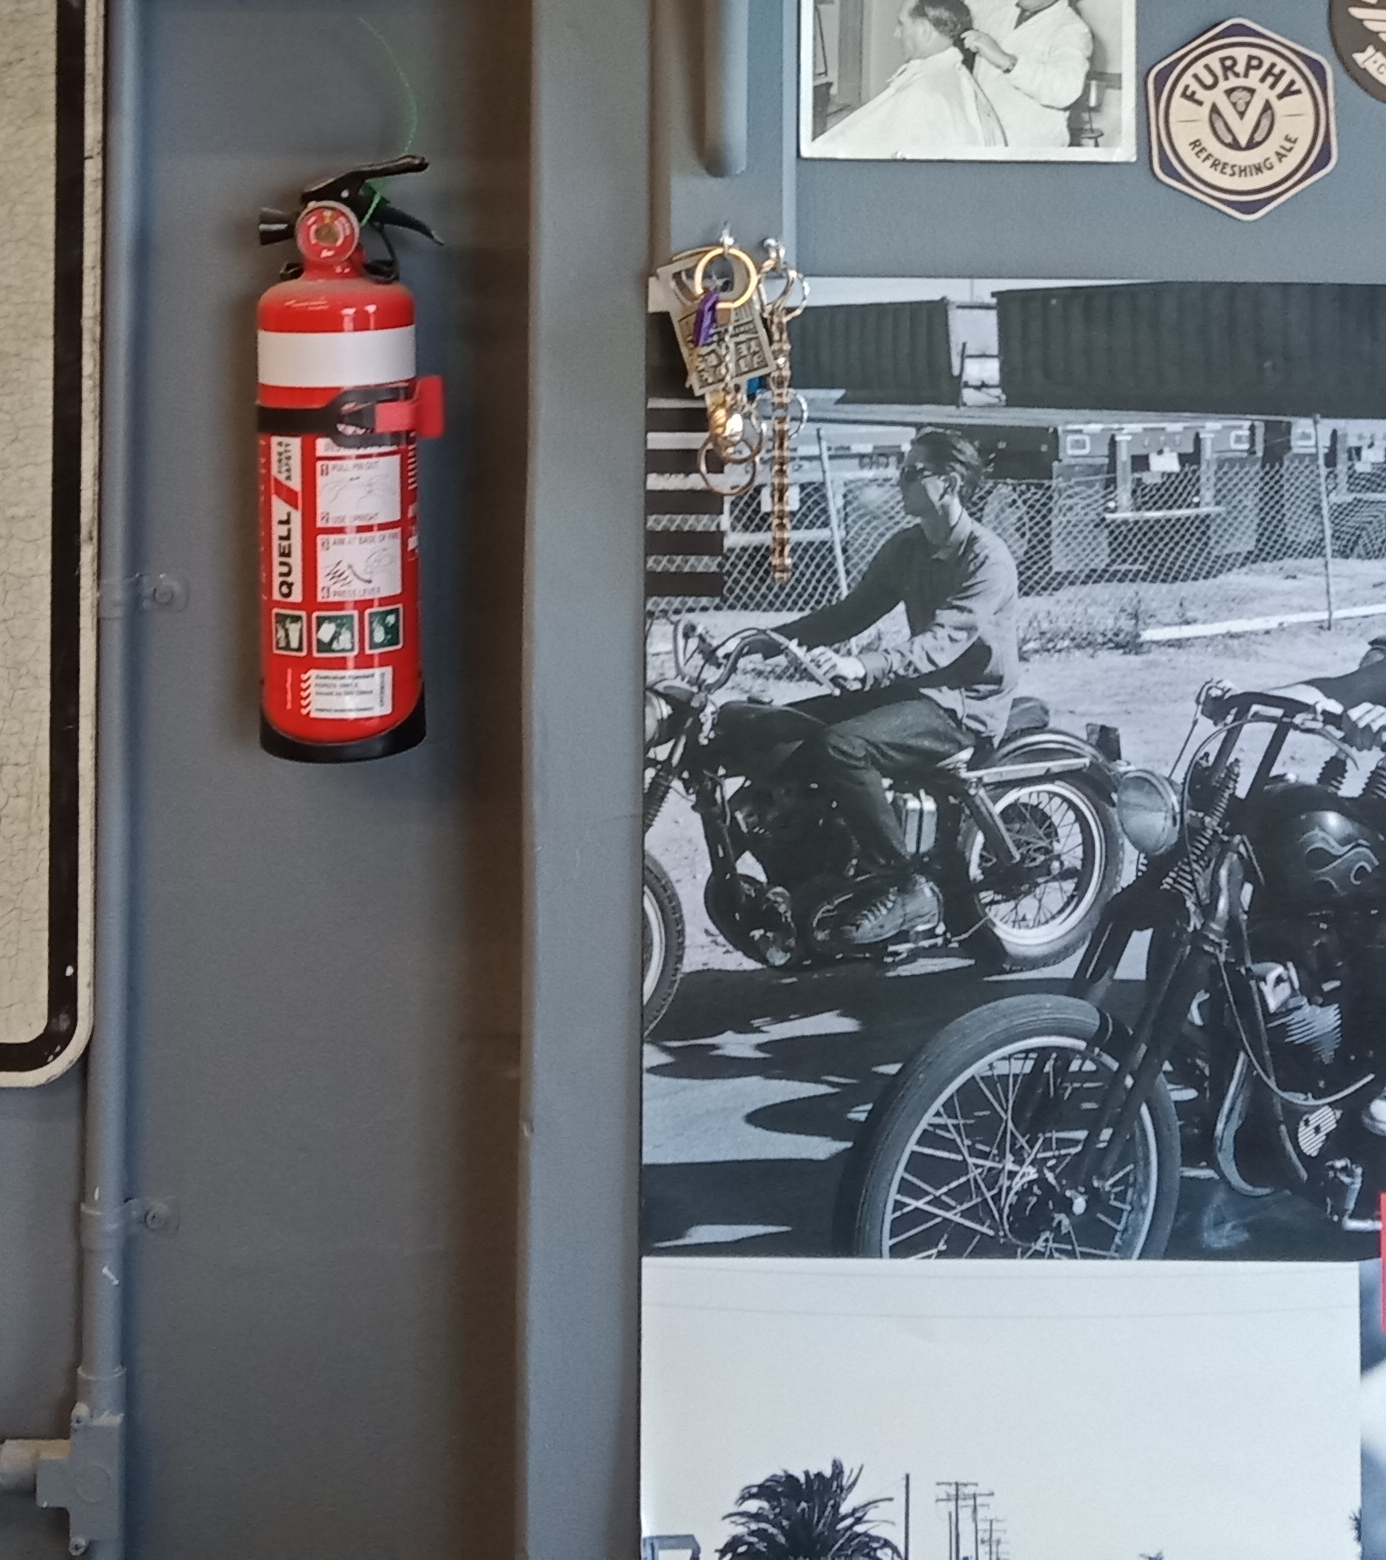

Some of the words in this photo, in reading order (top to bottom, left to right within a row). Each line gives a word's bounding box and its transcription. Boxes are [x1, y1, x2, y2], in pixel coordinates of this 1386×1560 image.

[1180, 55, 1302, 107] FURPHY
[1188, 138, 1276, 178] REFRESHING
[1273, 133, 1299, 167] ALE
[277, 511, 294, 599] QUELL
